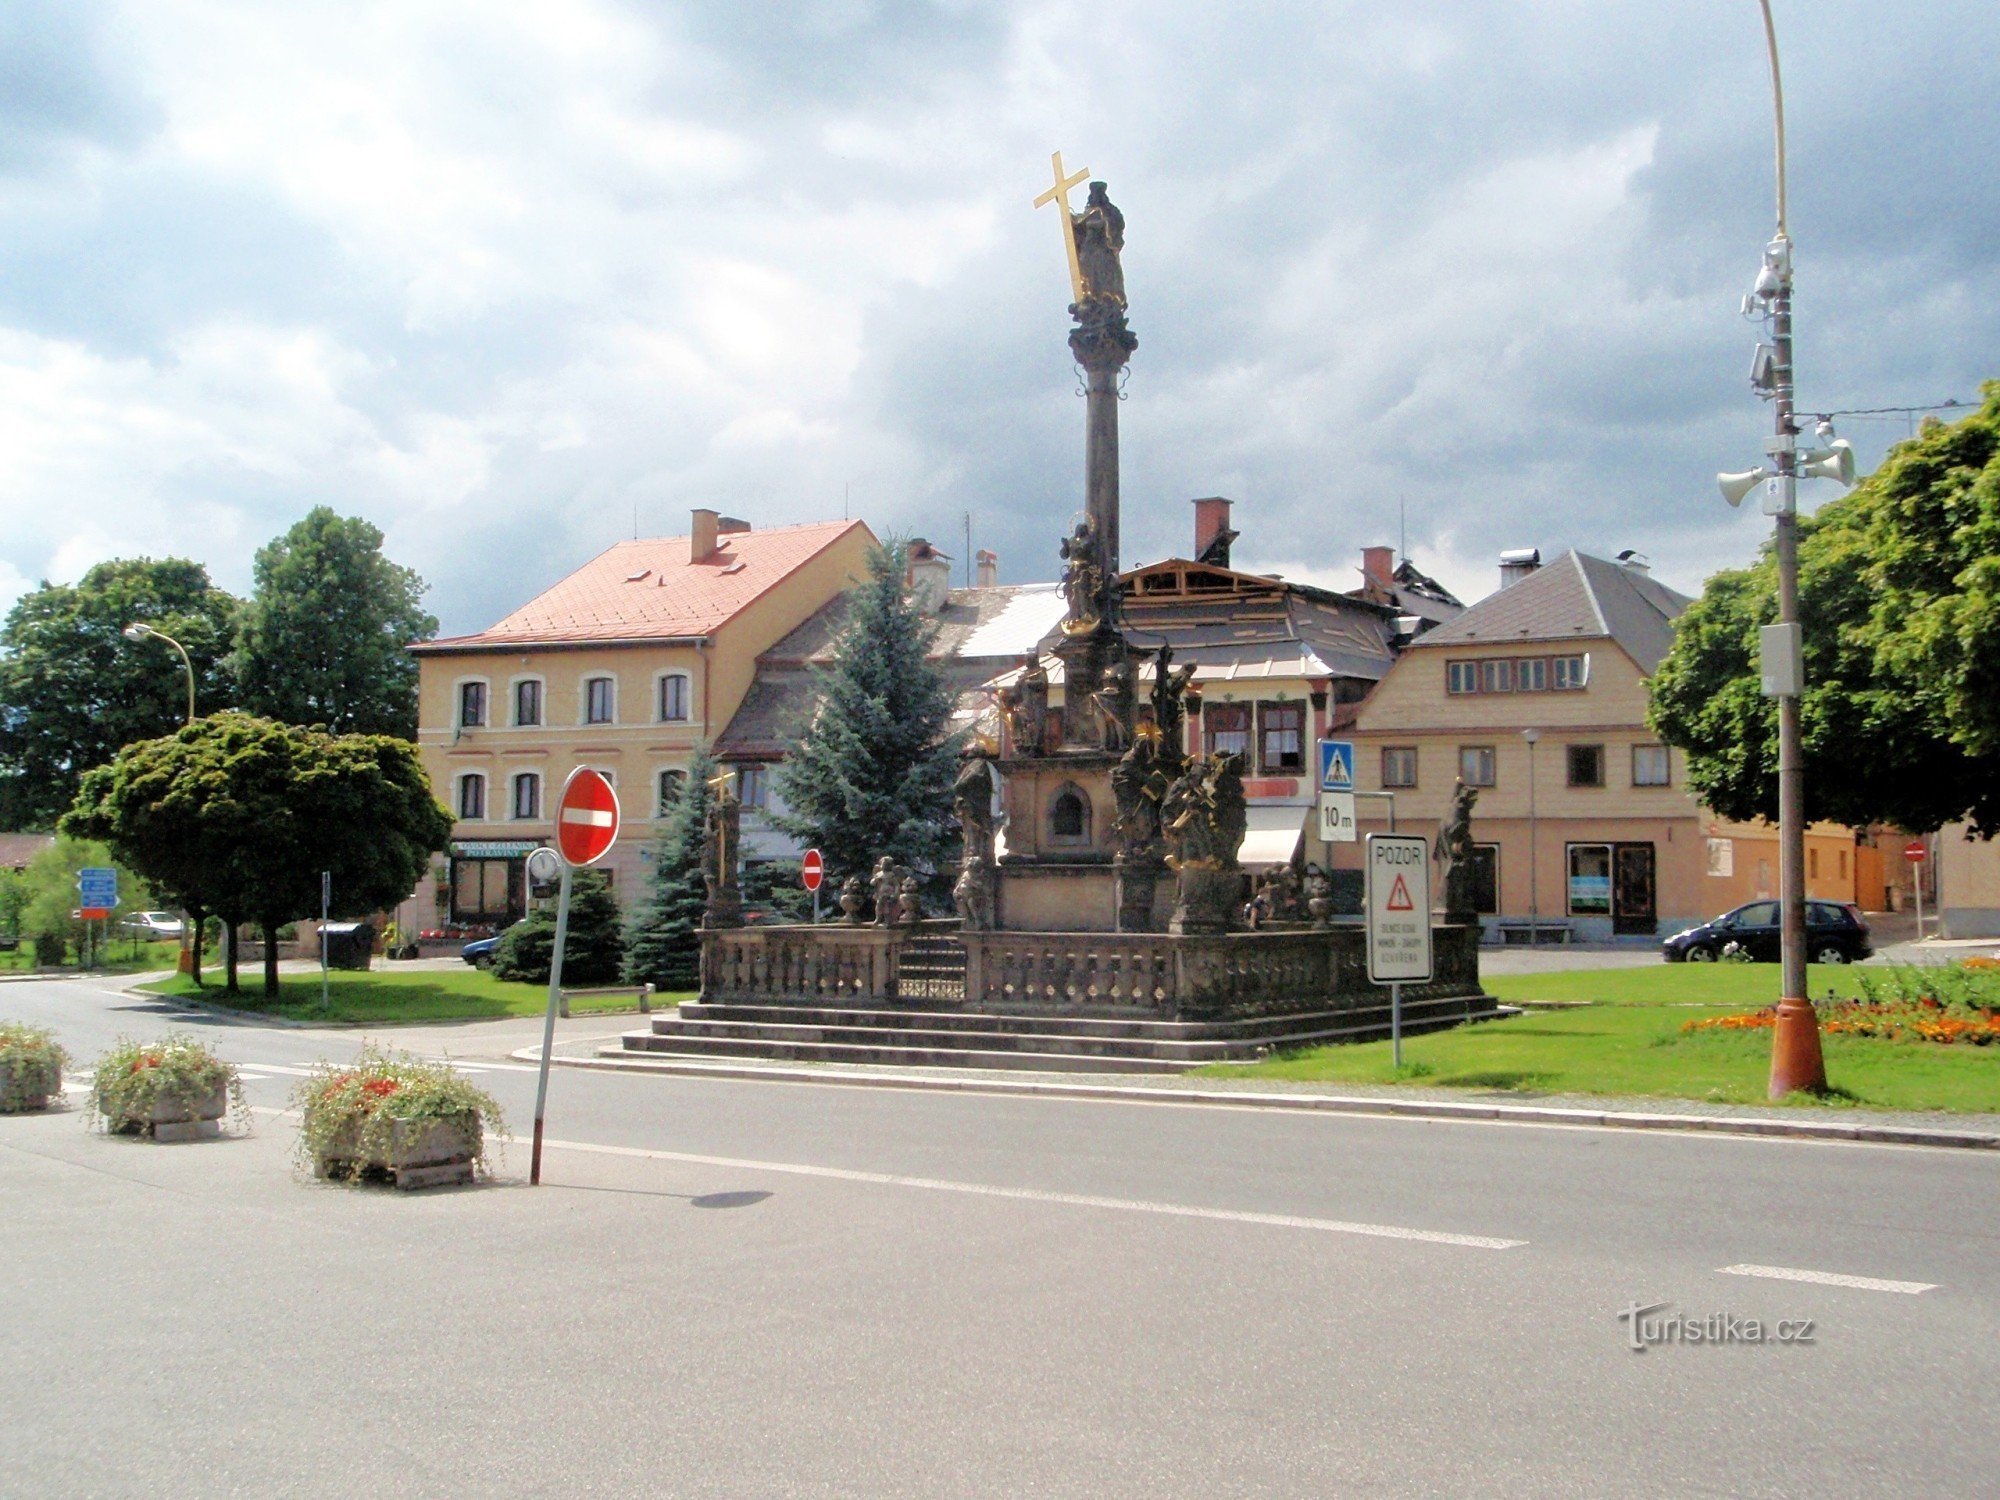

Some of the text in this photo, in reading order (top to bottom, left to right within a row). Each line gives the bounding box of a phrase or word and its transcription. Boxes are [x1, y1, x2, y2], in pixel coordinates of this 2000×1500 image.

[1325, 806, 1352, 828] 10 m
[1376, 846, 1421, 865] POZOR
